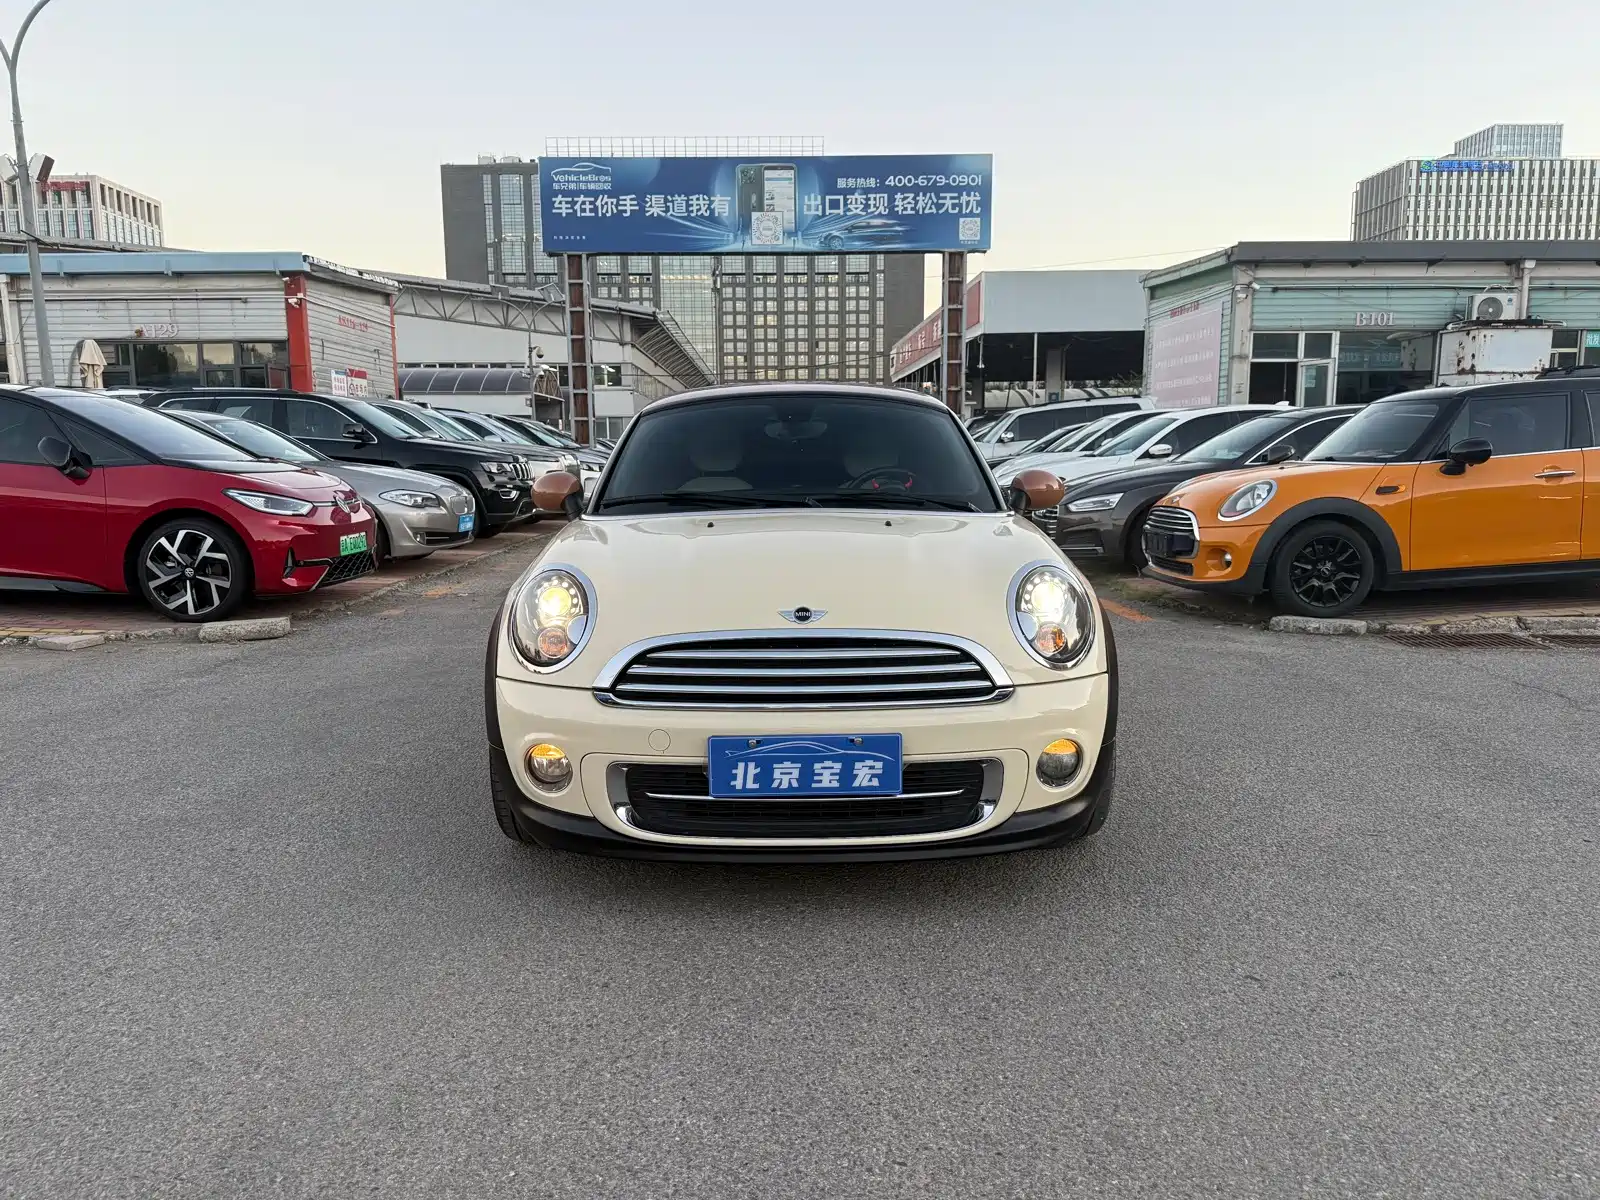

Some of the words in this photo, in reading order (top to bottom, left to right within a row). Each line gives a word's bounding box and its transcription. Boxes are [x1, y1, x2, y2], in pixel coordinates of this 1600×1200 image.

[552, 174, 612, 182] VehicleBros
[885, 175, 982, 187] 400-679-0901
[551, 194, 639, 217] 车在你手
[645, 194, 732, 217] 渠道我有
[803, 193, 888, 216] 出口变现
[894, 192, 981, 214] 轻松无忧
[1355, 311, 1396, 326] B101
[730, 760, 883, 790] 北京宝宏
